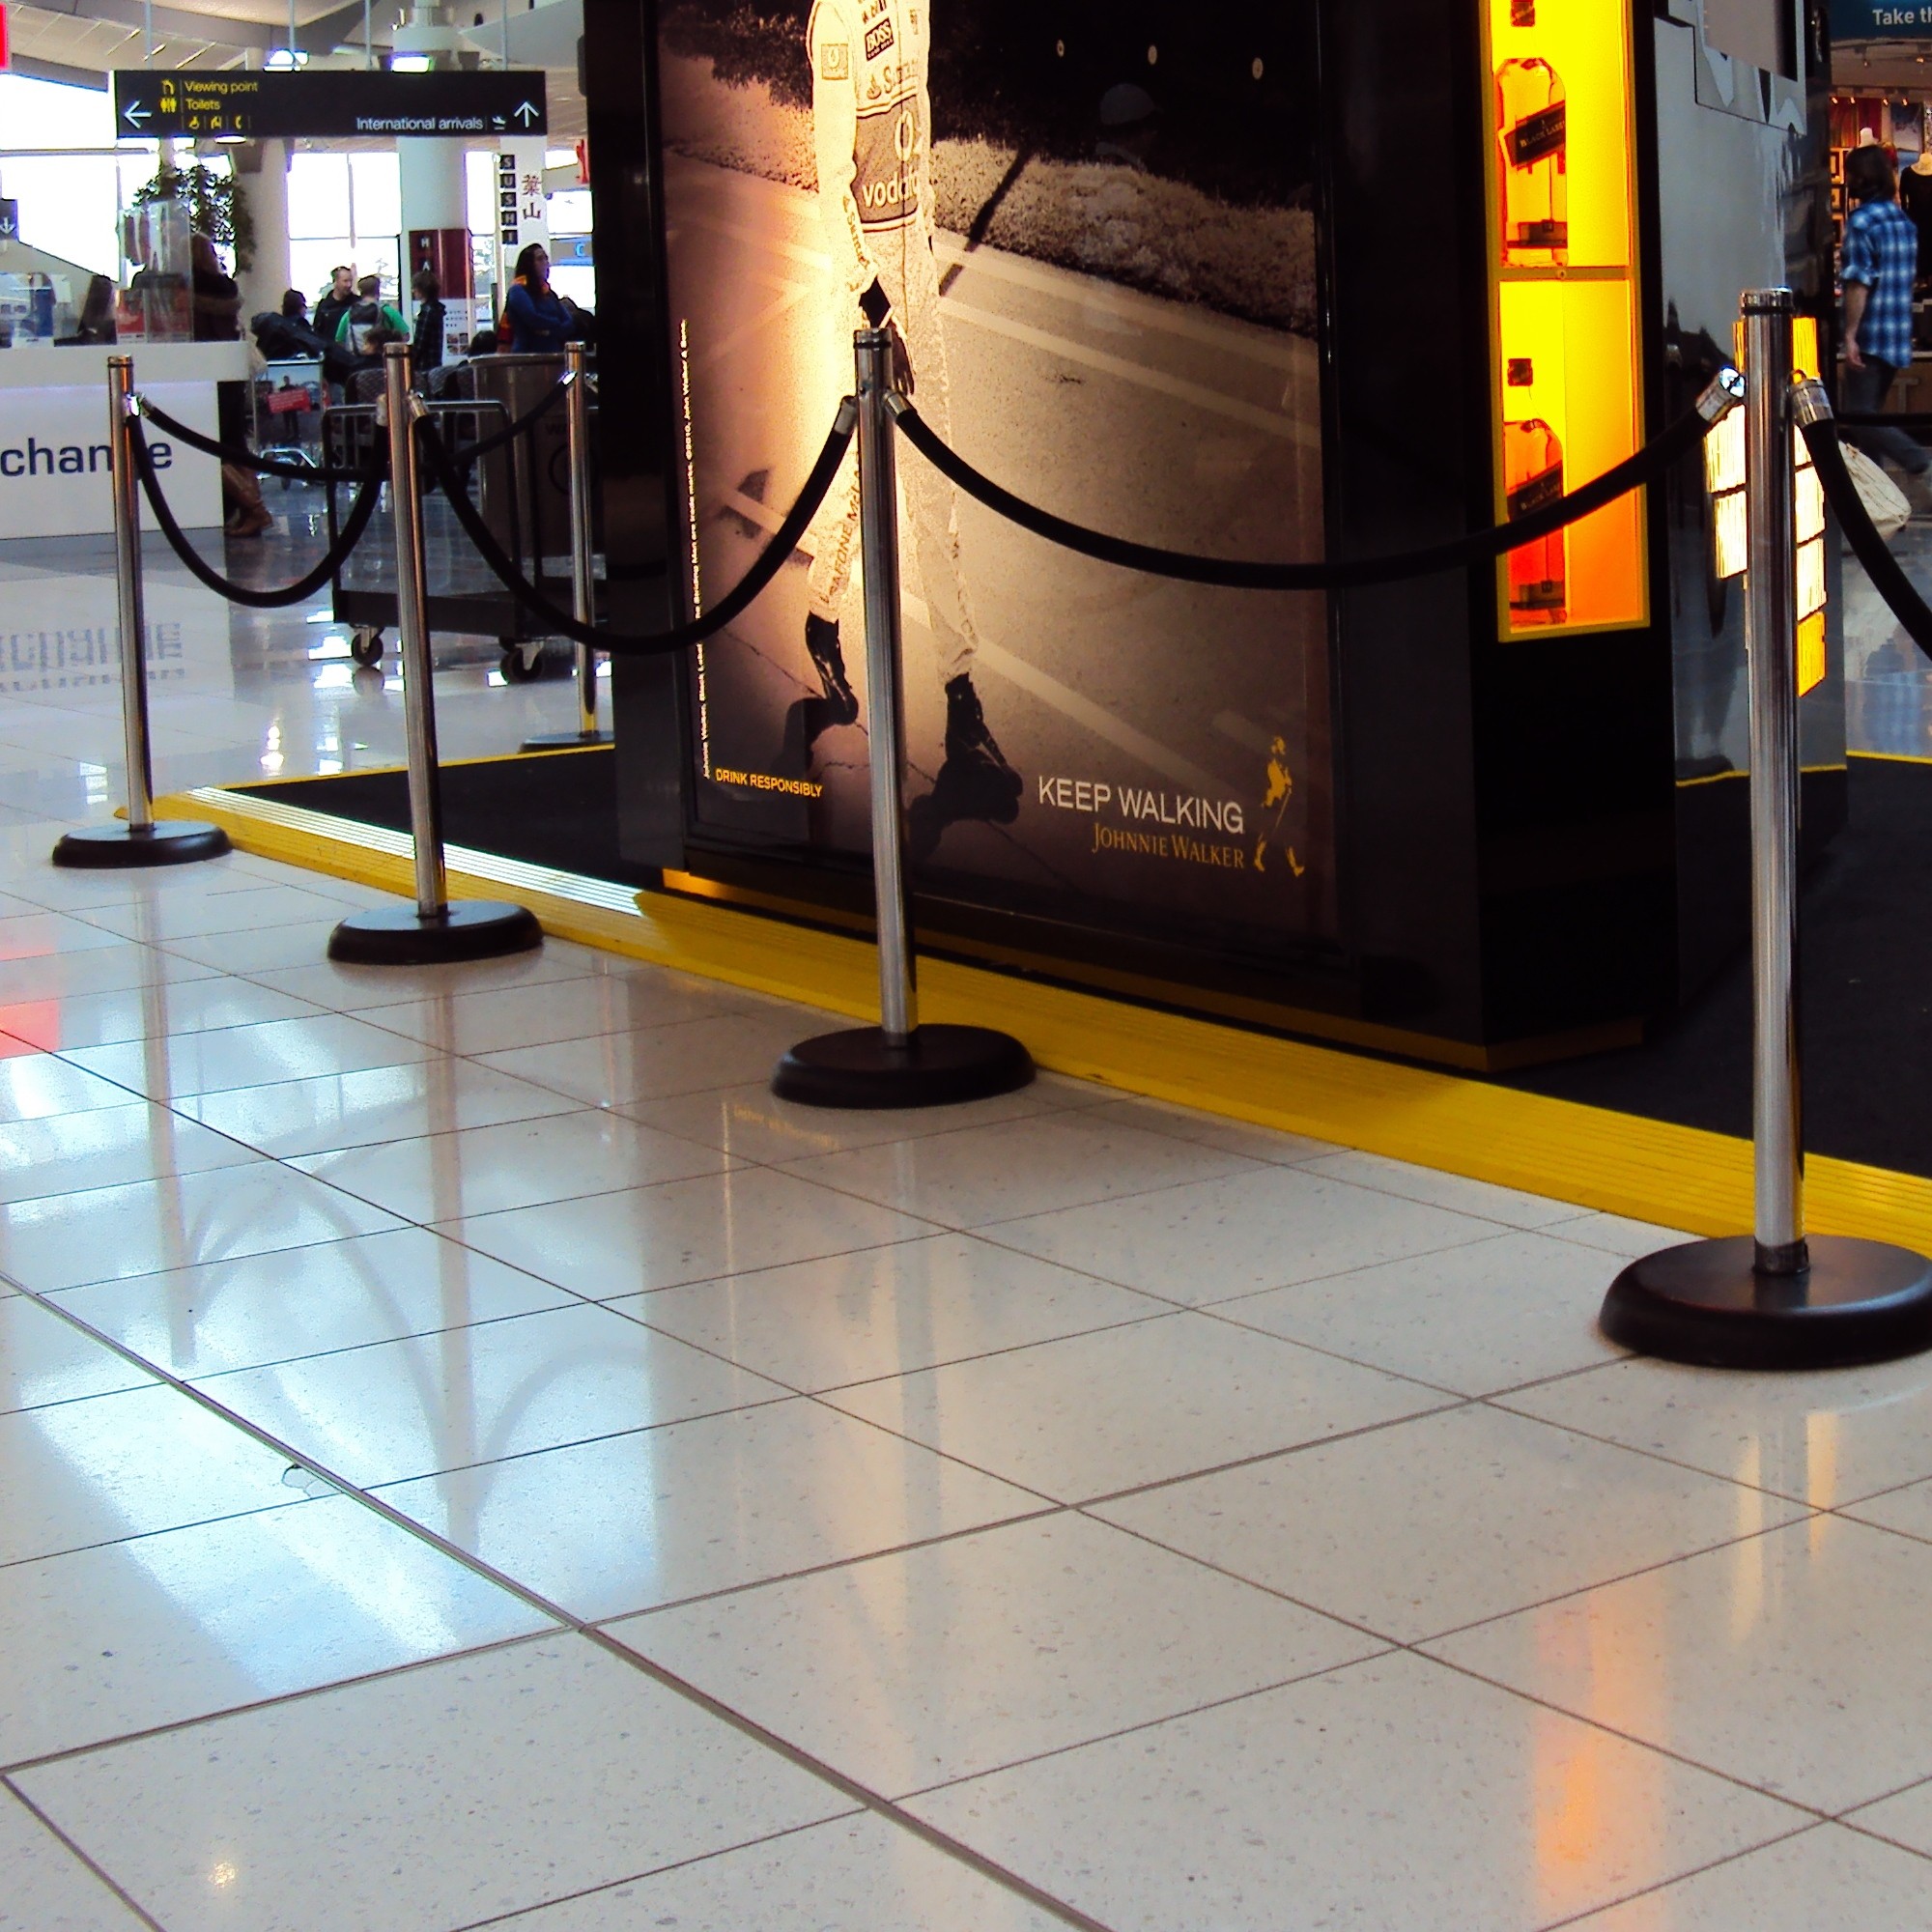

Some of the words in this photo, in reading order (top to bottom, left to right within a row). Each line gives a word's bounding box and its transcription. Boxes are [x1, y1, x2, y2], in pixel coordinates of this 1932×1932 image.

[1872, 9, 1915, 25] Take
[185, 81, 228, 95] Viewing
[231, 81, 259, 94] point
[186, 99, 221, 110] Toilets
[356, 117, 436, 130] International
[439, 117, 484, 130] arrivals
[501, 155, 517, 243] SUSHI
[0, 438, 172, 477] chane
[716, 768, 748, 785] DRINK
[750, 774, 822, 797] RESPONSIBLY
[1038, 776, 1111, 812] KEEP
[1118, 786, 1244, 834] WALKING
[1092, 822, 1168, 858] JOHNNIE
[1171, 834, 1244, 868] WALKER
